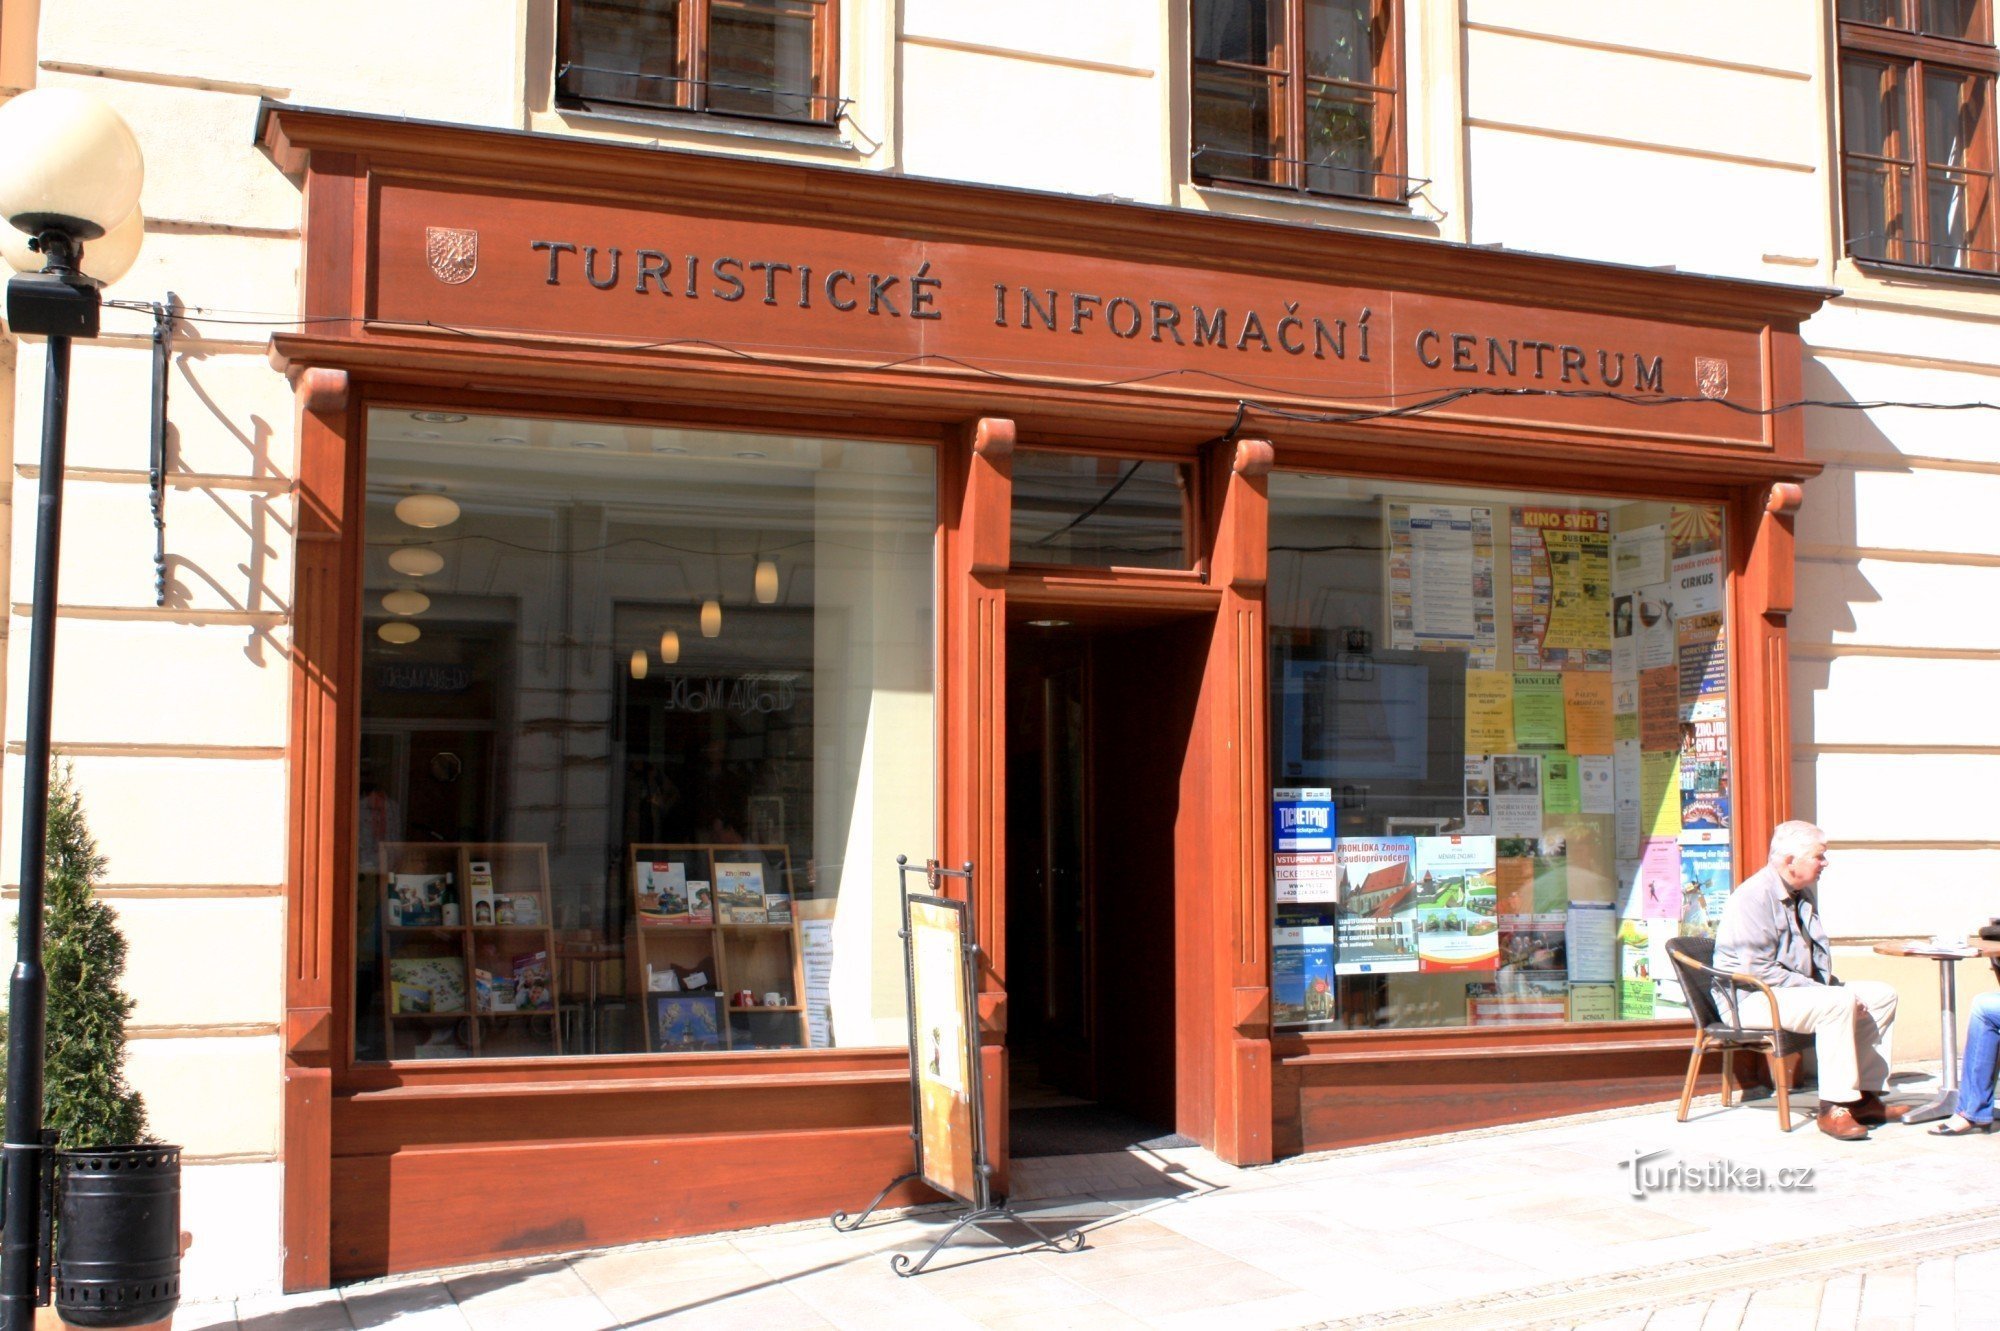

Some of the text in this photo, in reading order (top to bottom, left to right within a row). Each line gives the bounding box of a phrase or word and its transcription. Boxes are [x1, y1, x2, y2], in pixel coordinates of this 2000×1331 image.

[530, 240, 1664, 393] TURISTICKÉ INFORMAČNÍ CENTRUM
[1523, 510, 1597, 529] KINO SVĚT
[1562, 533, 1591, 543] DUBEN
[1681, 572, 1713, 589] CIRKUS
[1514, 676, 1561, 686] KONCERT
[1716, 736, 1728, 751] CU
[1279, 807, 1330, 829] TICKETPRO
[1337, 842, 1410, 854] PROHLÍDKA Znojma
